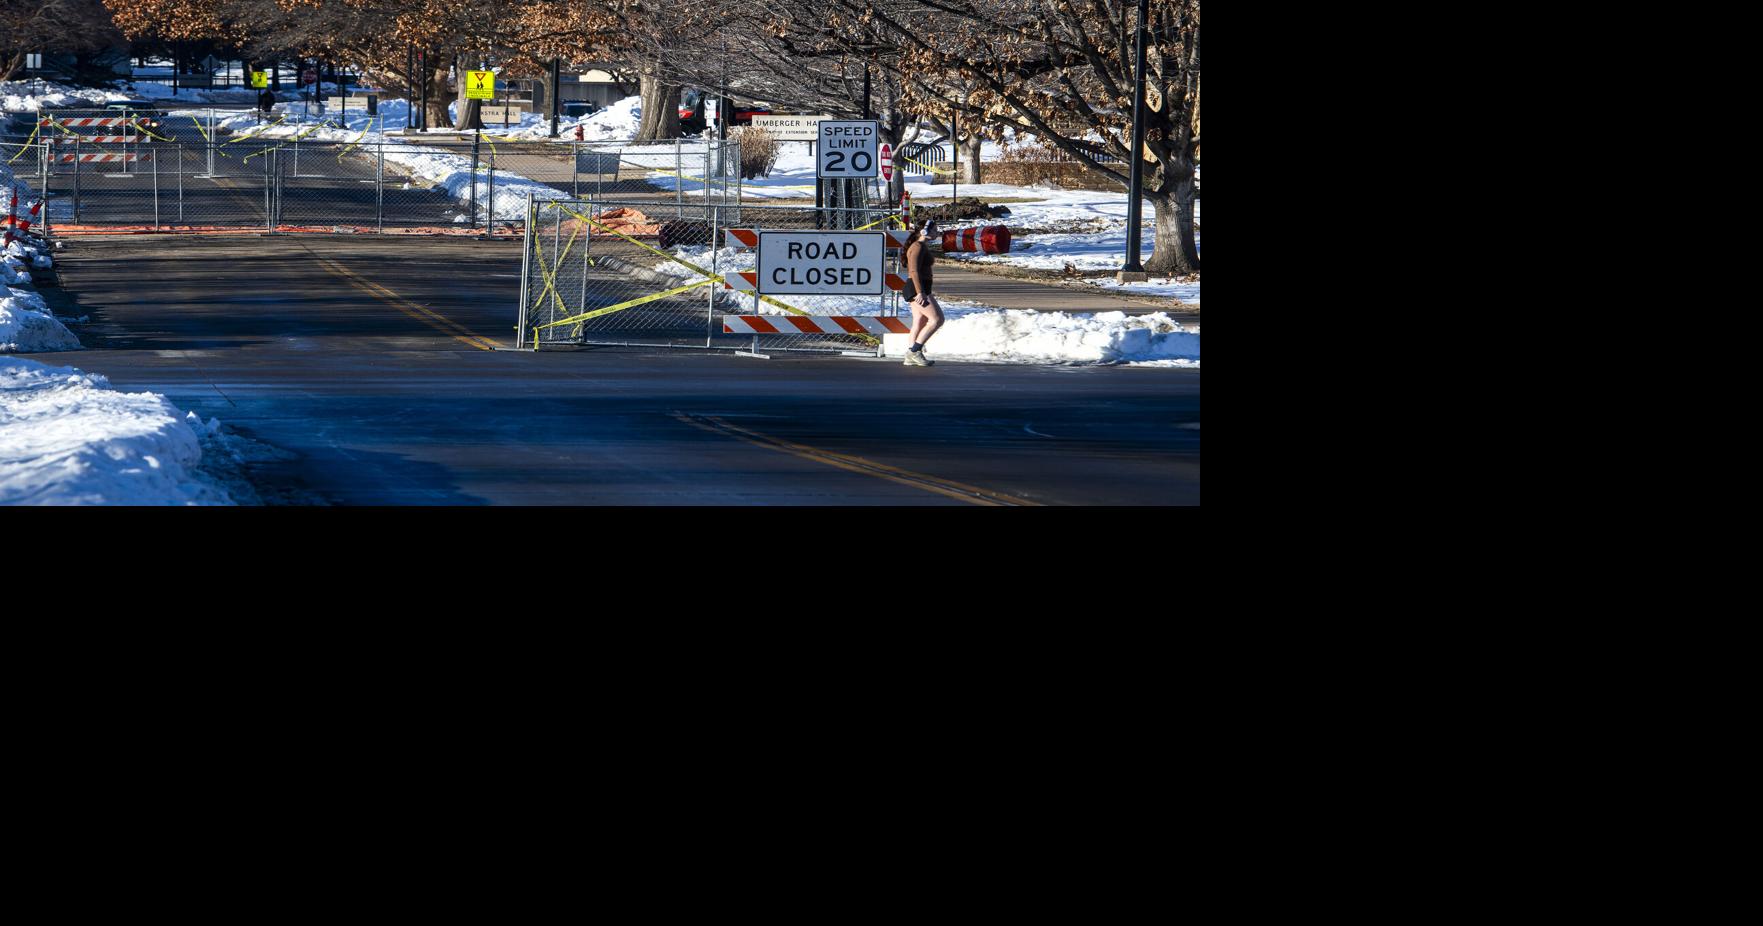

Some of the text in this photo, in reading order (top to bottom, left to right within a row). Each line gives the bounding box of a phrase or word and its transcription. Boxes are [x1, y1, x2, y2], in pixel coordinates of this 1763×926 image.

[824, 126, 873, 136] SPEED
[829, 139, 868, 149] LIMIT
[824, 151, 873, 172] 20
[788, 242, 858, 260] ROAD
[772, 267, 872, 286] CLOSED
